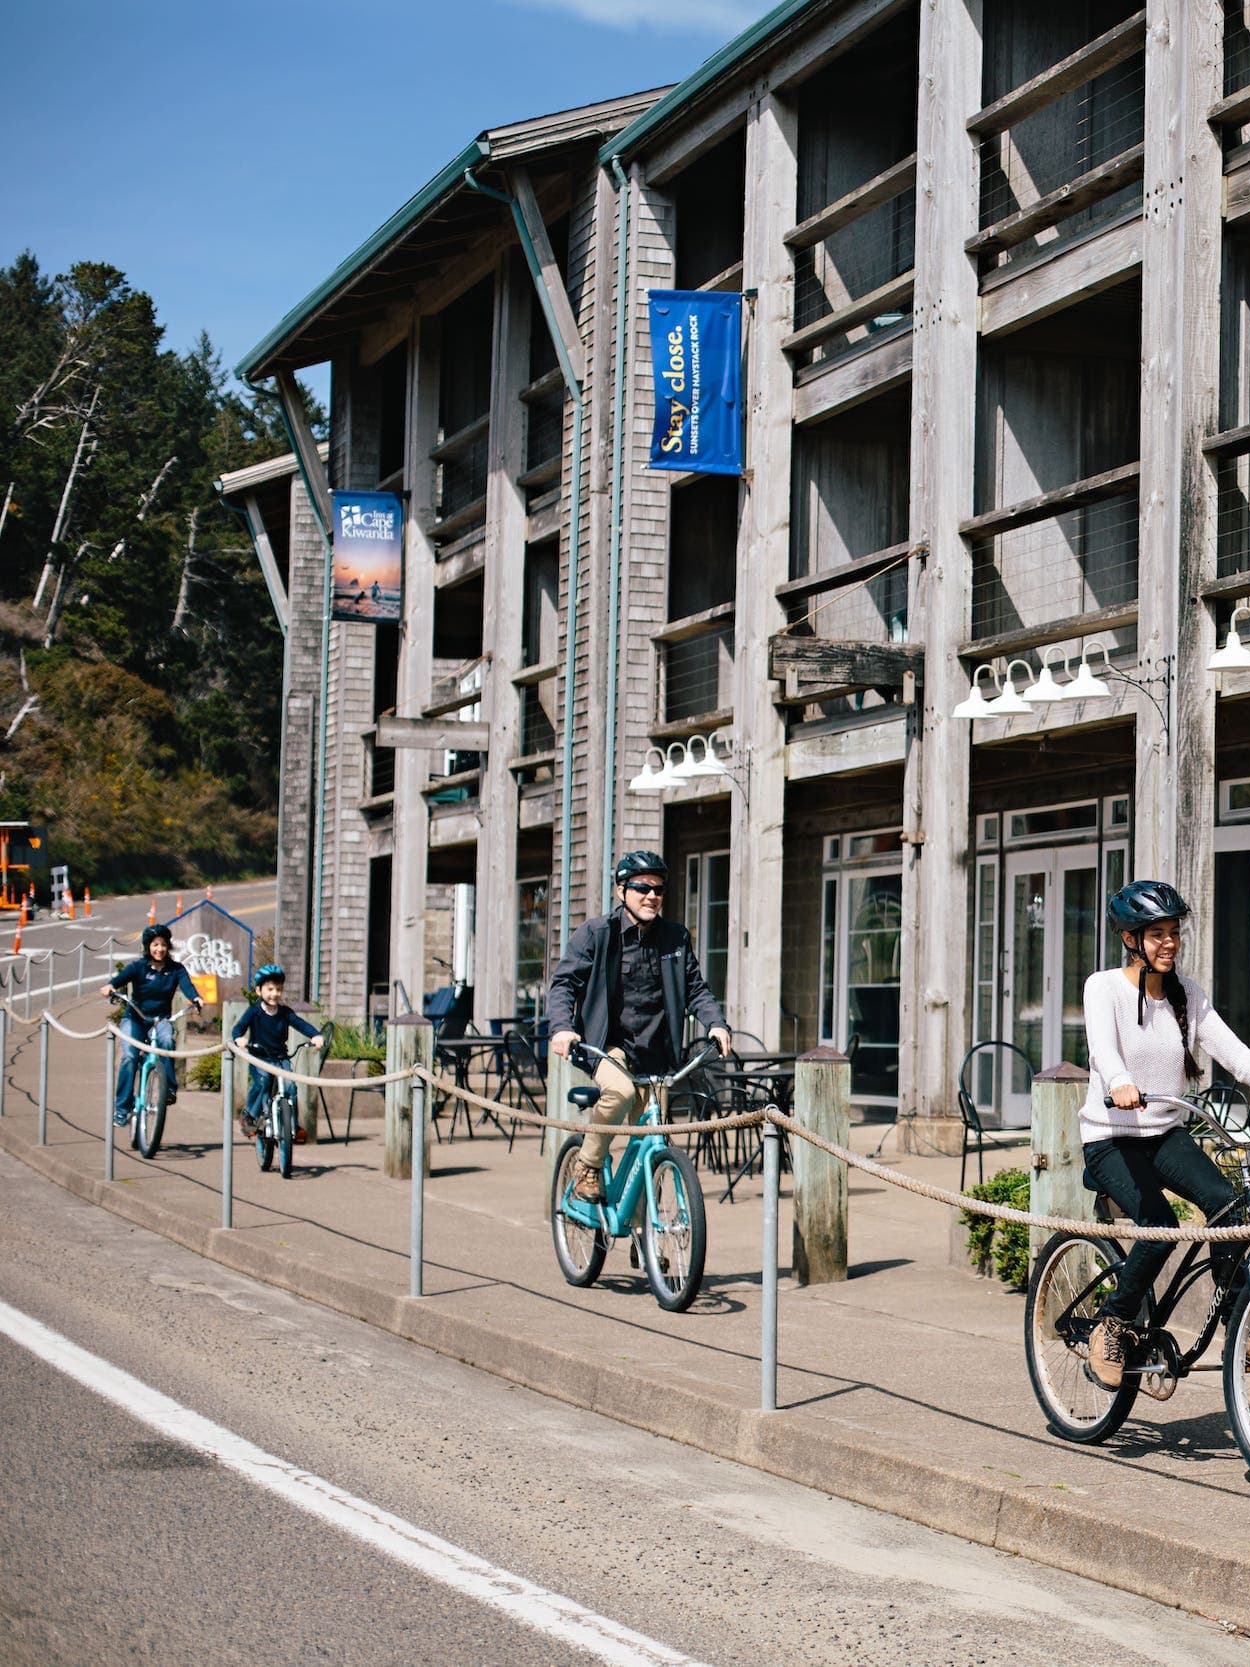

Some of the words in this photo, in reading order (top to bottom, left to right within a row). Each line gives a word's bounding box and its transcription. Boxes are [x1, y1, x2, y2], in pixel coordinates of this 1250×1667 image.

[689, 314, 699, 340] ROCK
[662, 325, 686, 392] close.
[691, 341, 700, 387] HAYSTACK
[691, 387, 700, 414] OVER
[661, 399, 690, 453] Stay
[690, 414, 699, 455] SUNSETS
[361, 512, 394, 531] Cape
[372, 510, 386, 519] Inn
[341, 525, 394, 540] Kiwanda
